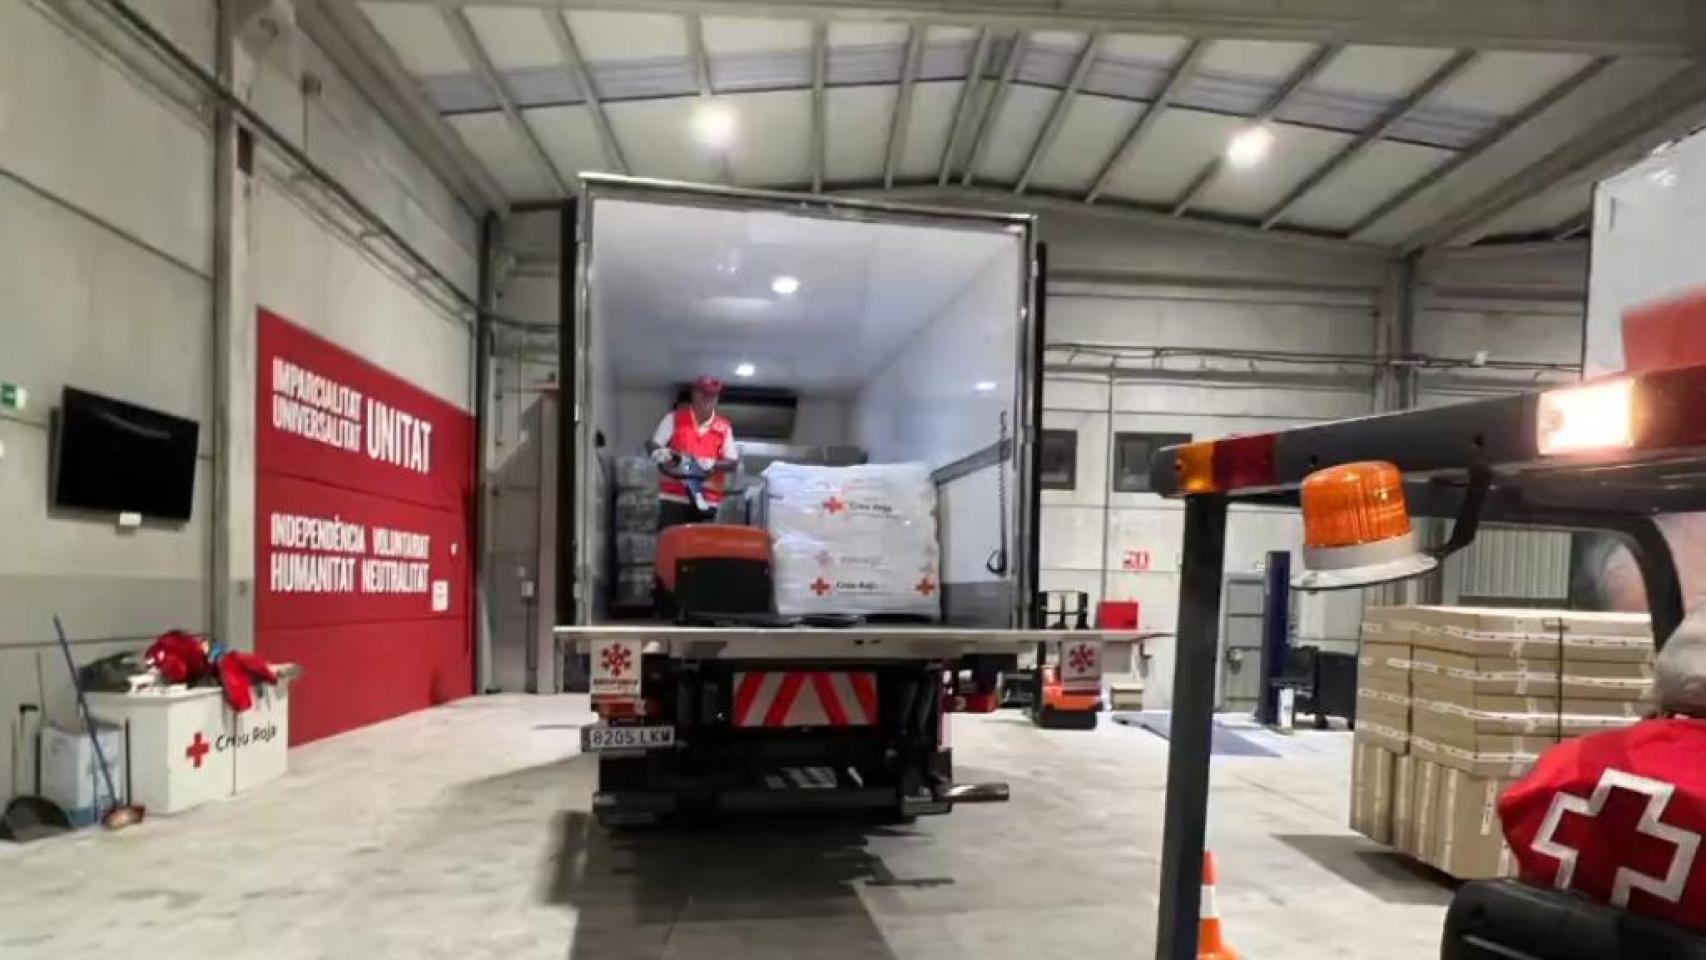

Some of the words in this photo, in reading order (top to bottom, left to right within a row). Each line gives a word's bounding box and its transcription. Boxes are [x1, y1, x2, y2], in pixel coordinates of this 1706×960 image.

[272, 394, 362, 452] UNIVERSALITAT
[367, 397, 432, 474] UNITAT
[270, 553, 355, 592] HUMANITAT
[362, 558, 429, 593] NEUTRALITAT
[252, 725, 276, 743] Roja
[592, 730, 635, 745] 8205
